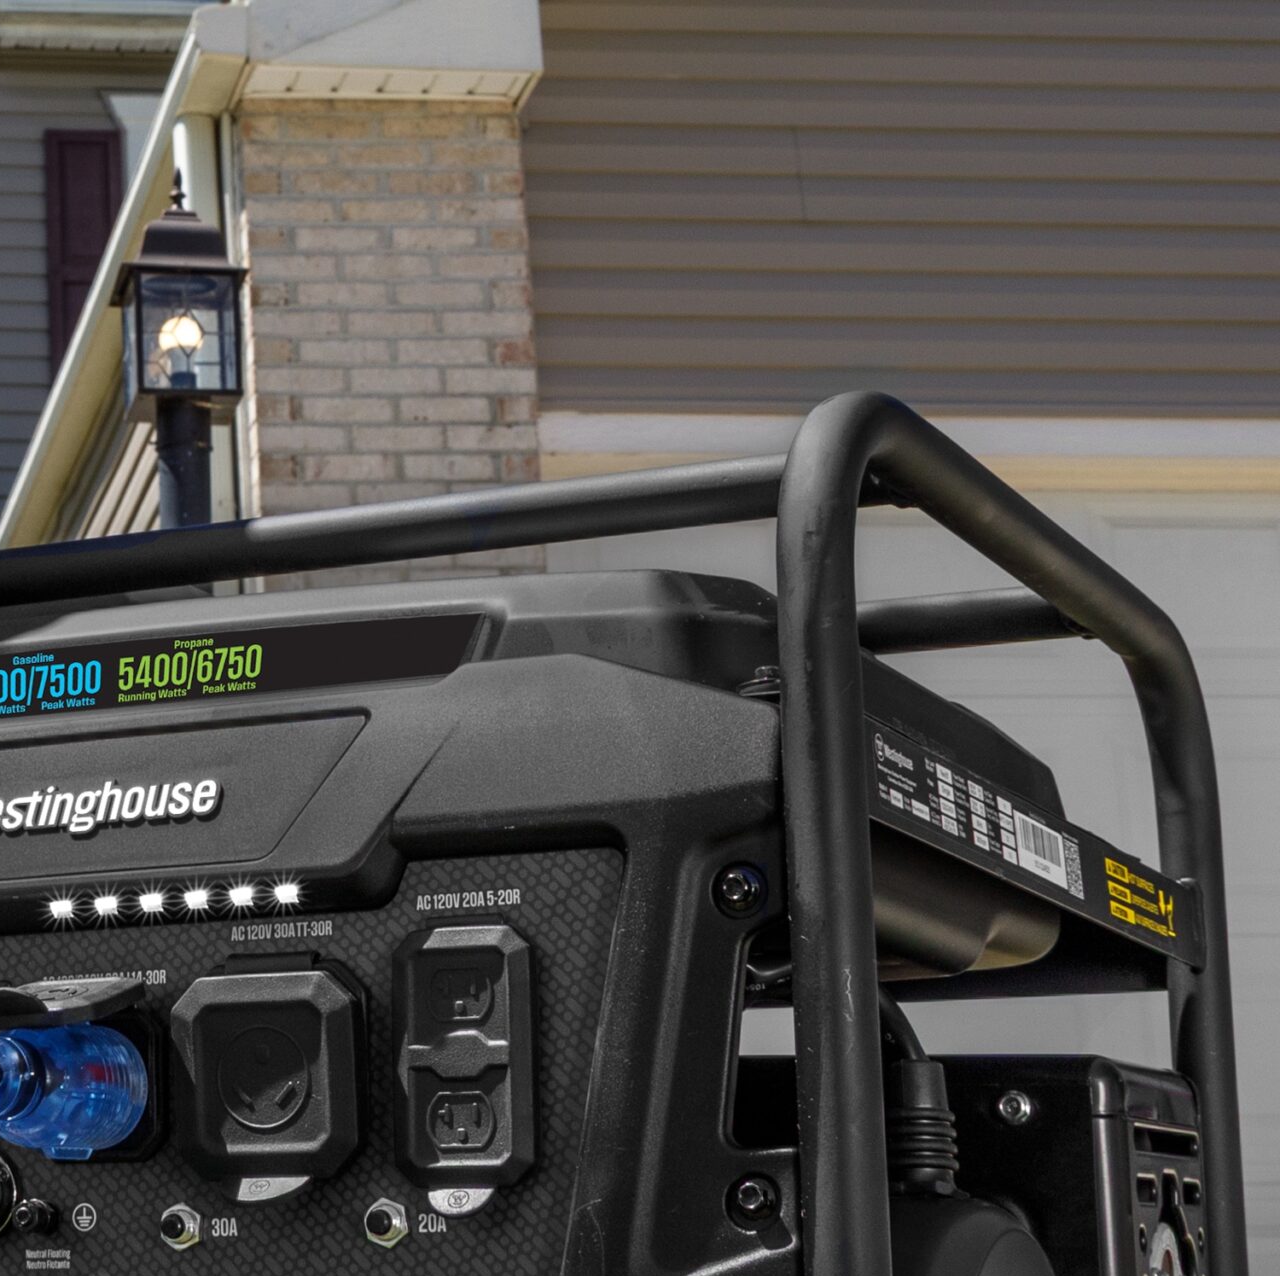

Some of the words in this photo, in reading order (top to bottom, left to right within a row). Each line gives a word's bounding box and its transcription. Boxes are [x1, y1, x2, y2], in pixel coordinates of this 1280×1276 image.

[174, 638, 214, 650] Propane
[12, 653, 55, 666] Gasoline
[118, 644, 263, 691] 5400/6750
[118, 690, 157, 702] Running
[158, 688, 187, 698] Watts
[202, 684, 225, 694] Peak
[227, 681, 257, 692] Watts
[41, 699, 64, 711] Peak
[66, 697, 96, 708] Watts
[416, 894, 432, 911] AC
[432, 893, 460, 910] 120V
[462, 891, 486, 908] 20A
[487, 888, 521, 906] 5-20R
[231, 926, 246, 942] AC
[246, 924, 273, 940] 120V
[274, 922, 295, 938] 30A
[295, 920, 333, 937] TT-30R
[211, 1217, 238, 1237] 30A
[418, 1213, 447, 1233] 20A
